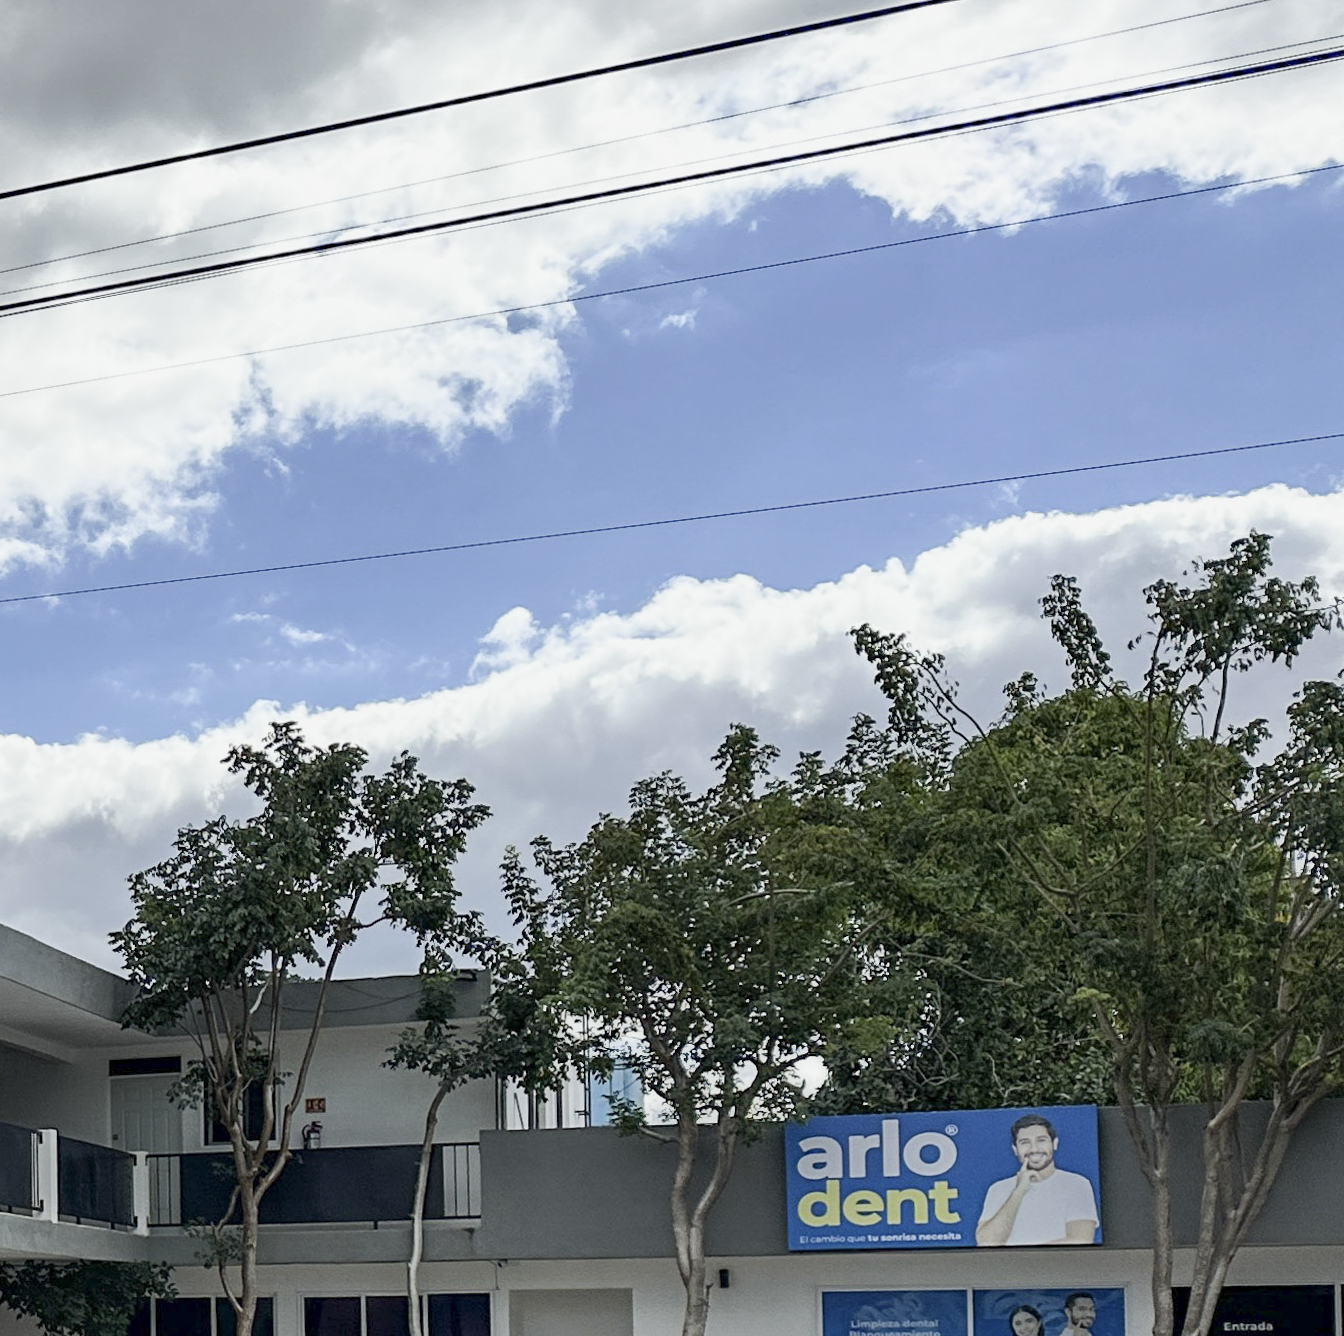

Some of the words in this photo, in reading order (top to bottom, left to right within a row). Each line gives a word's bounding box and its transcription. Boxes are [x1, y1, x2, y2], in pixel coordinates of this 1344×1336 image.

[797, 1179, 961, 1227] dent
[799, 1235, 809, 1244] El
[810, 1235, 846, 1244] cambio
[847, 1236, 866, 1245] que
[867, 1234, 879, 1242] tu
[880, 1233, 917, 1242] sonrisa
[918, 1232, 961, 1241] necesita
[851, 1319, 900, 1330] Limpieza
[902, 1319, 939, 1328] dental
[1223, 1322, 1273, 1331] Entrada
